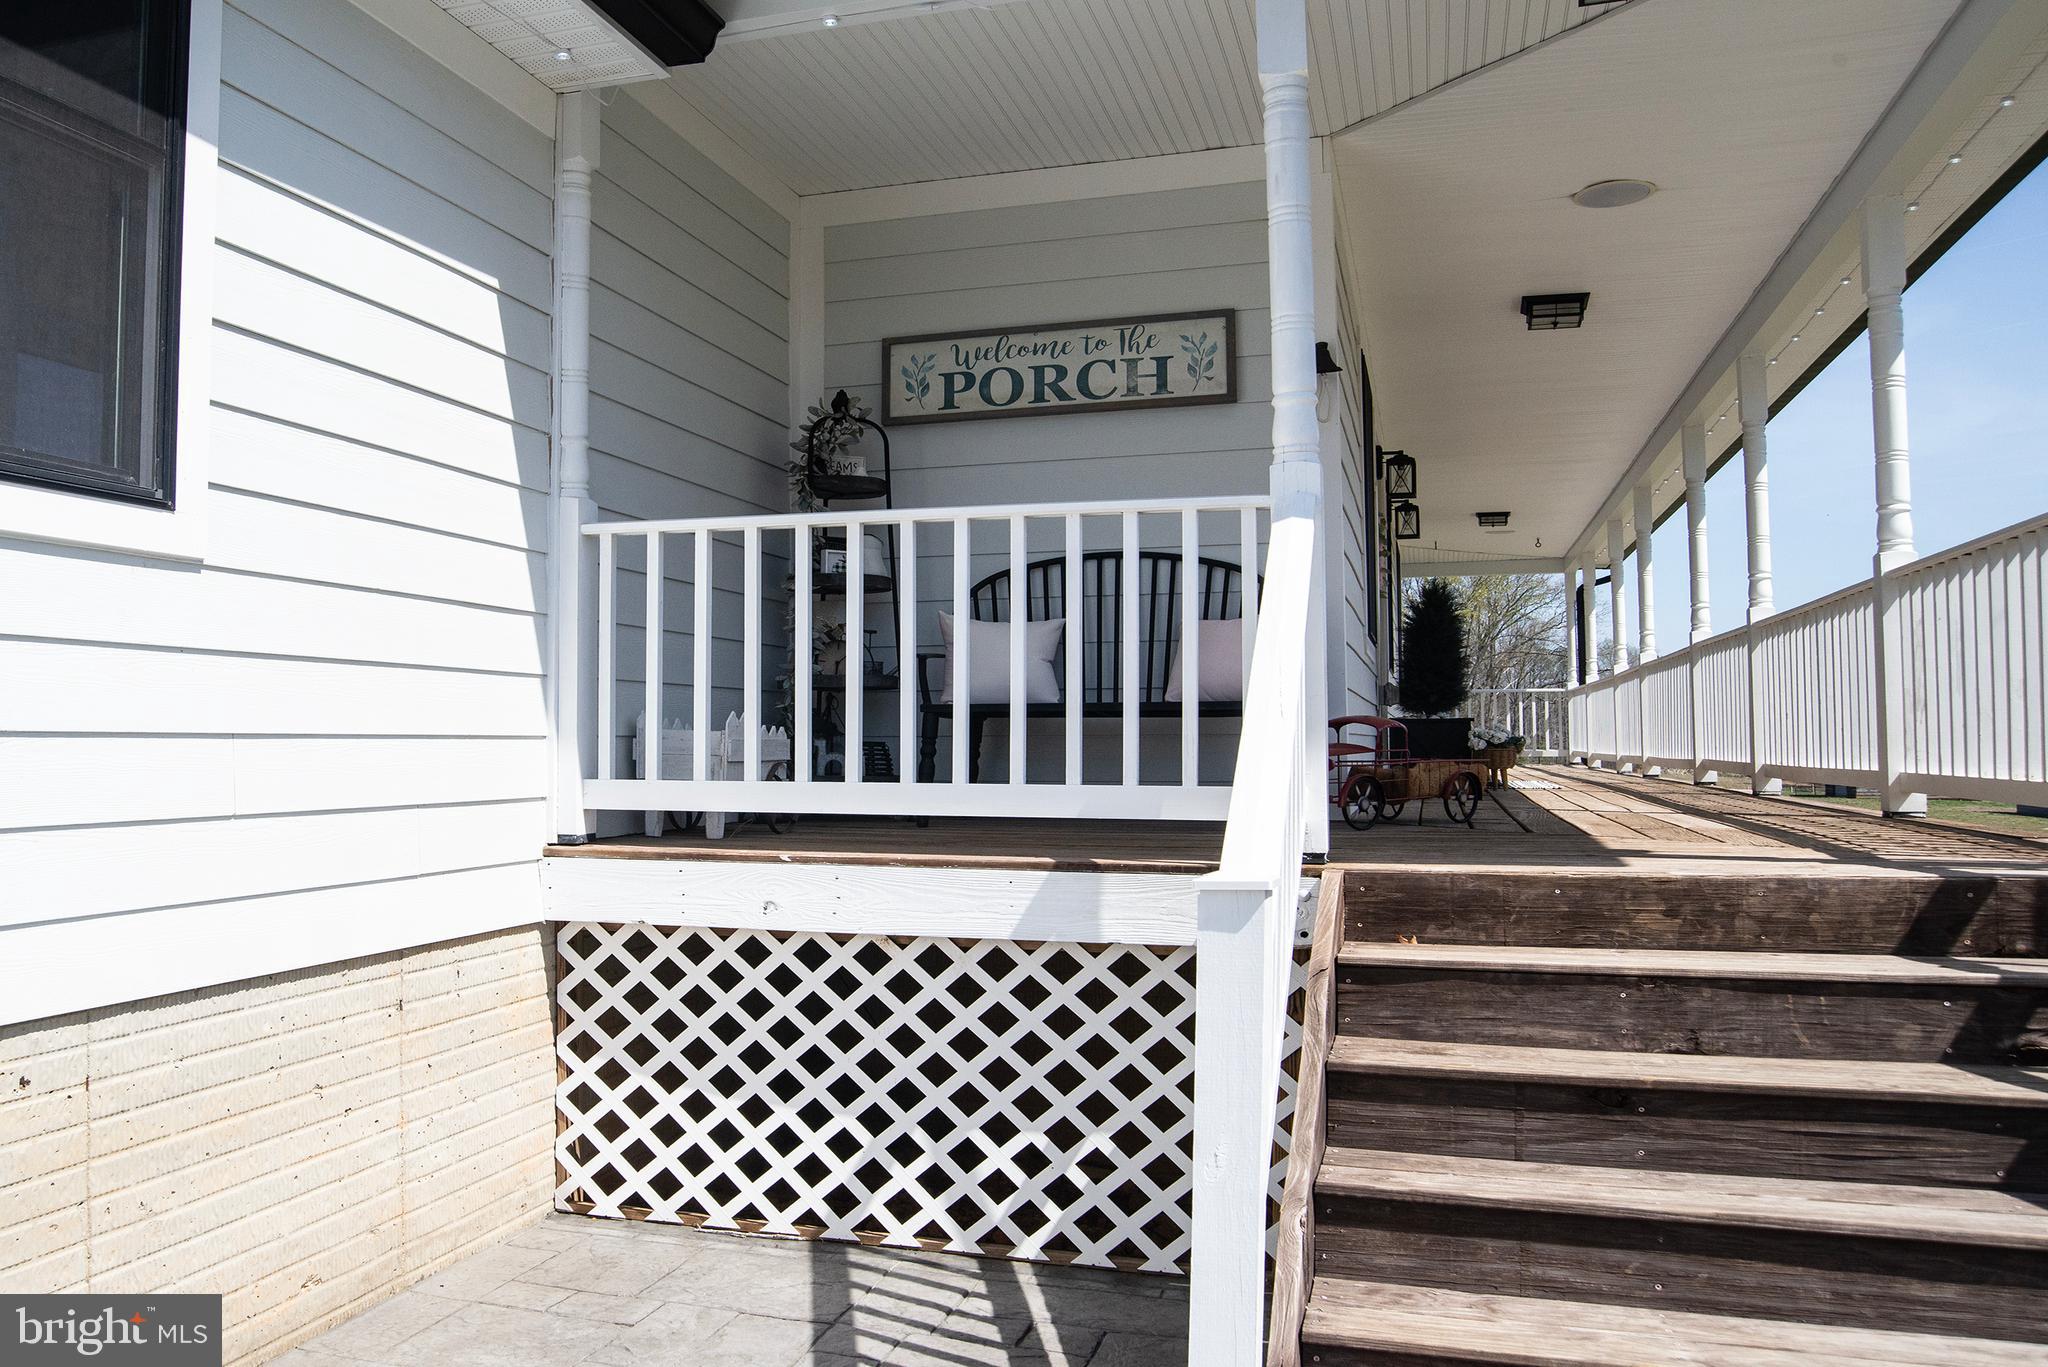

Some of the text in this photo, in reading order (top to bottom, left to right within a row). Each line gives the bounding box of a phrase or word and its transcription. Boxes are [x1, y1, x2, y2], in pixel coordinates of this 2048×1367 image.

[950, 333, 1075, 370] Welcome
[1078, 334, 1113, 357] to
[938, 355, 1175, 411] PORCH
